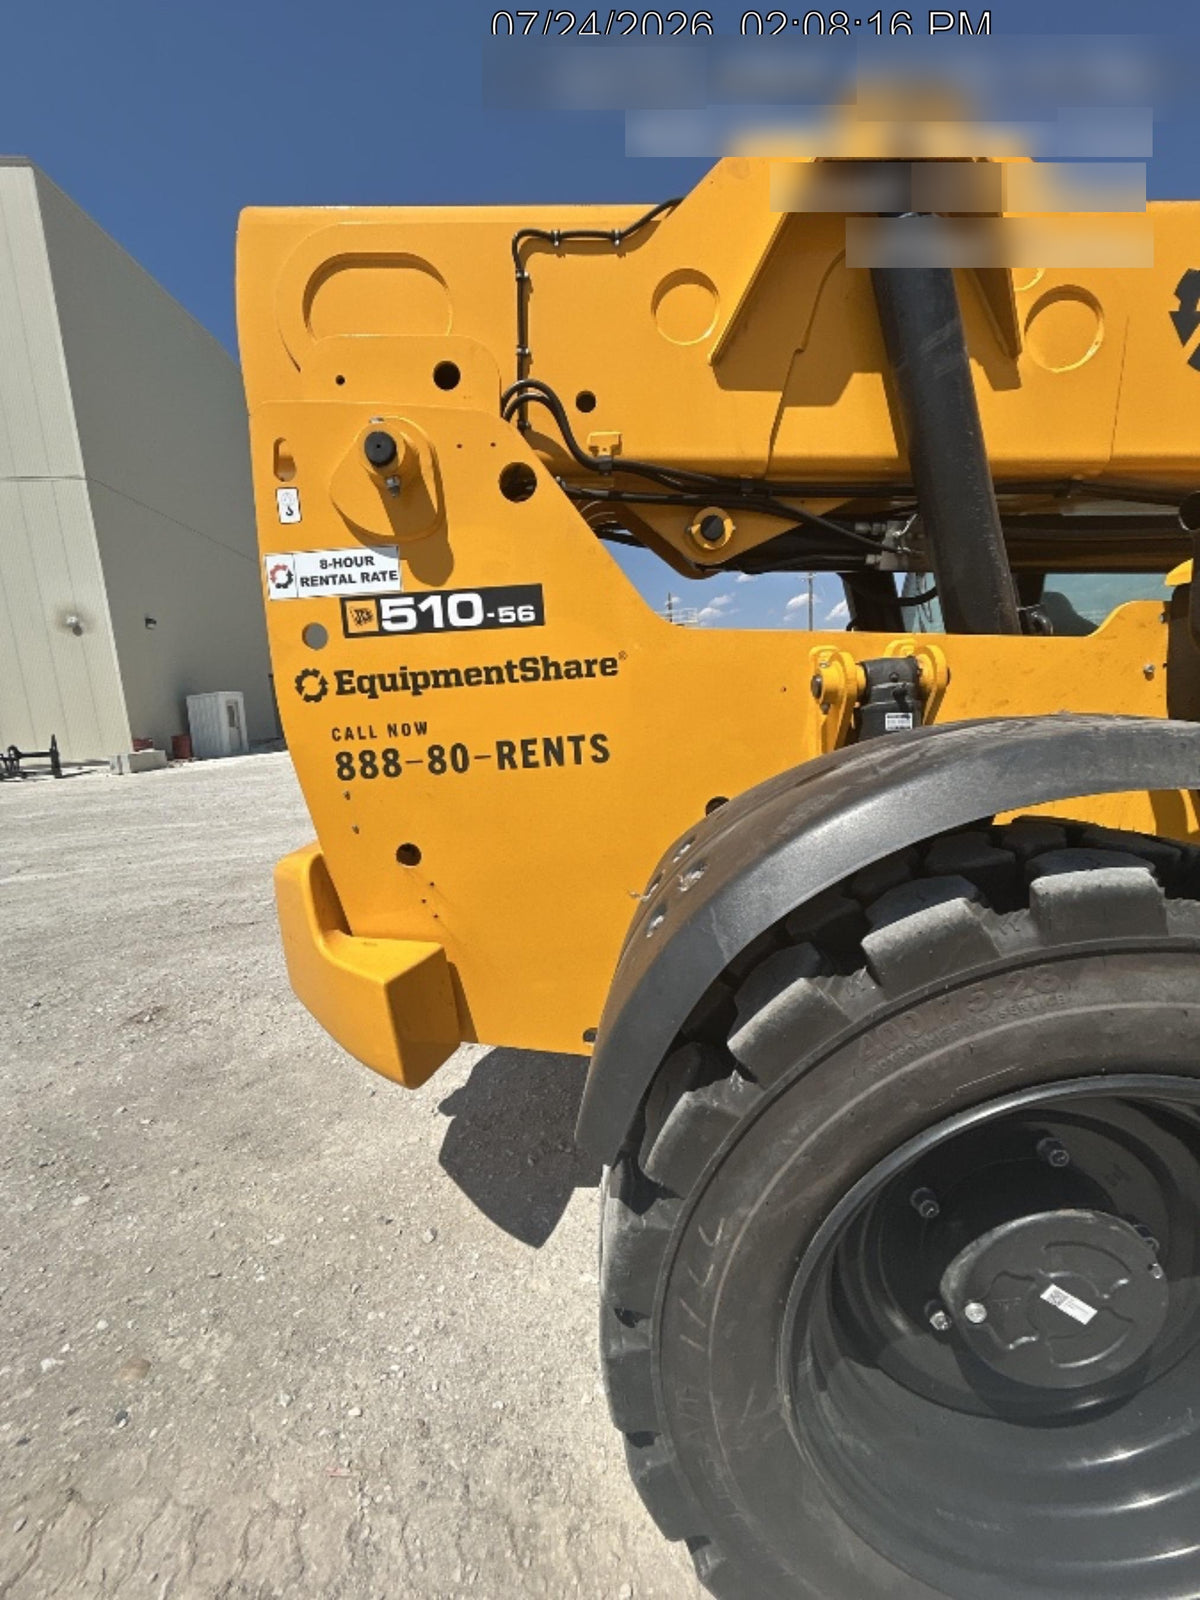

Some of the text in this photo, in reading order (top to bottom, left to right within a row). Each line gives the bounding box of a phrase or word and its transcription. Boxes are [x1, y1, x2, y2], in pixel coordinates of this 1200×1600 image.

[319, 555, 375, 569] 8-HOUR
[300, 570, 399, 588] RENTAL RATE
[380, 593, 536, 632] 510-56
[331, 721, 428, 742] CALL NOW
[335, 734, 611, 781] 888-80-RENTS
